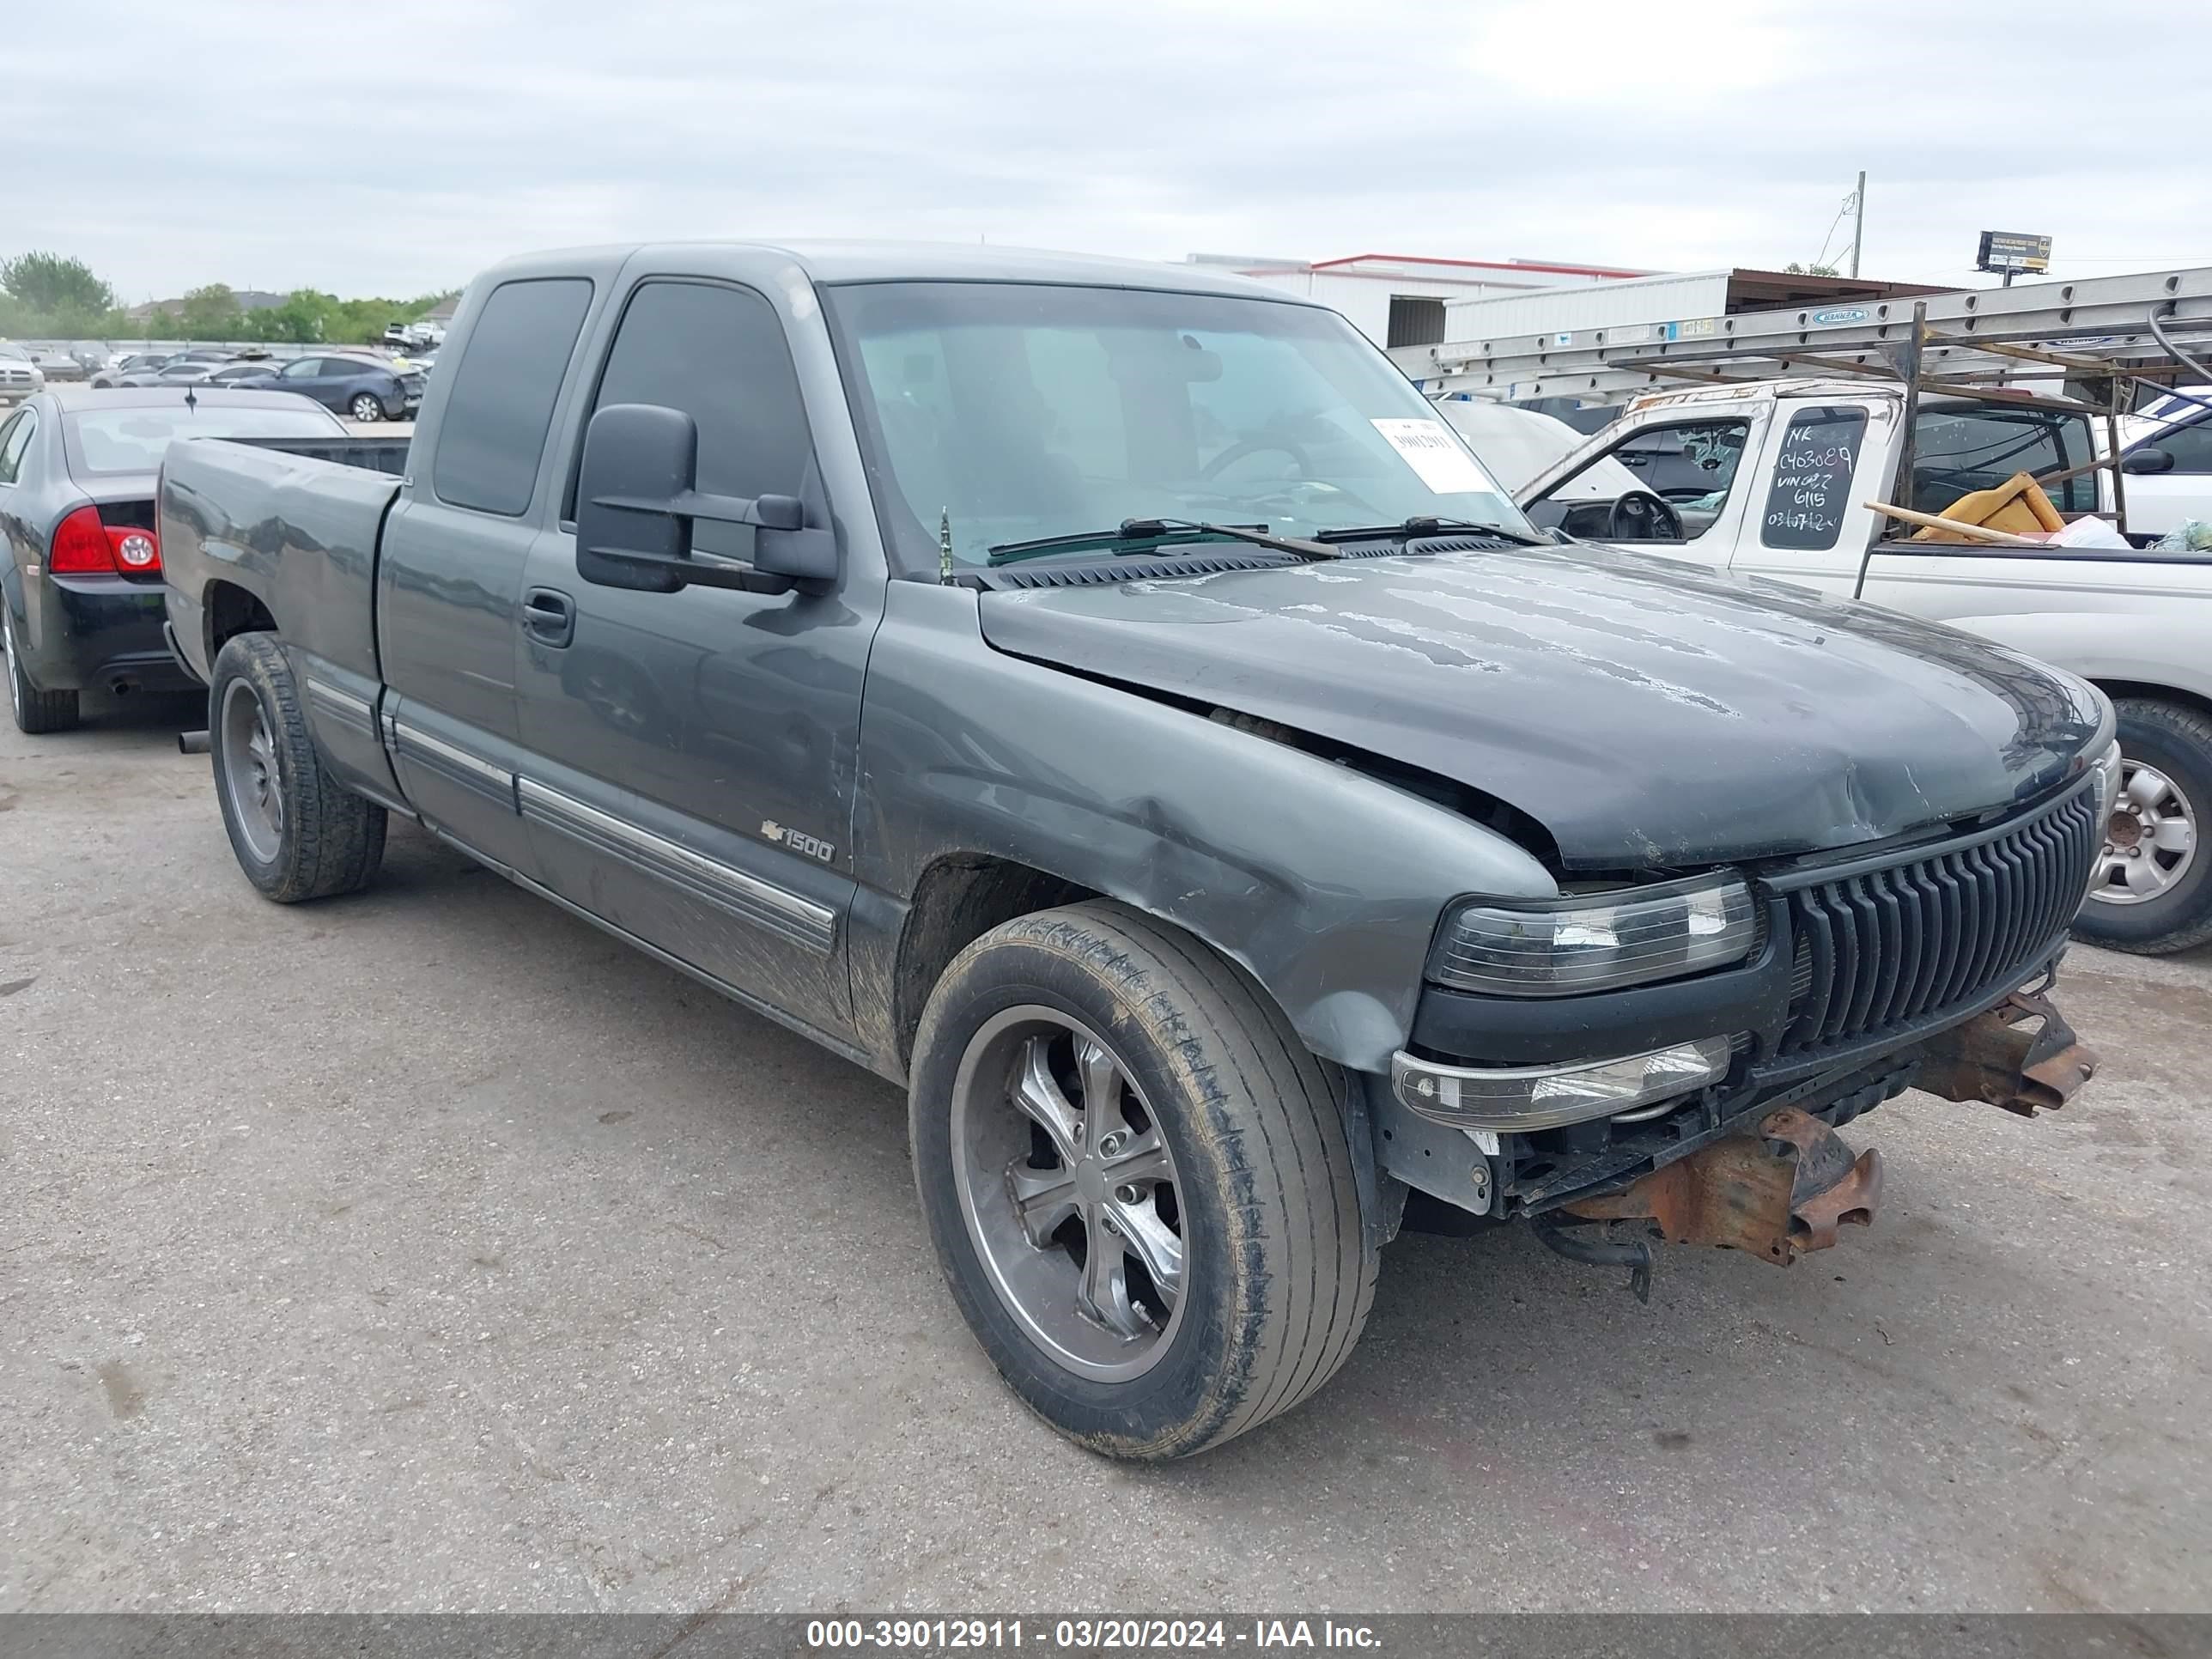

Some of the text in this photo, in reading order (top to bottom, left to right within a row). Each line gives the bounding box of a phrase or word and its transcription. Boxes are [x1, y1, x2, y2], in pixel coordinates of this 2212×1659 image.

[1780, 447, 1852, 474] C403089
[1778, 476, 1801, 488] VIN
[786, 830, 834, 861] 1500
